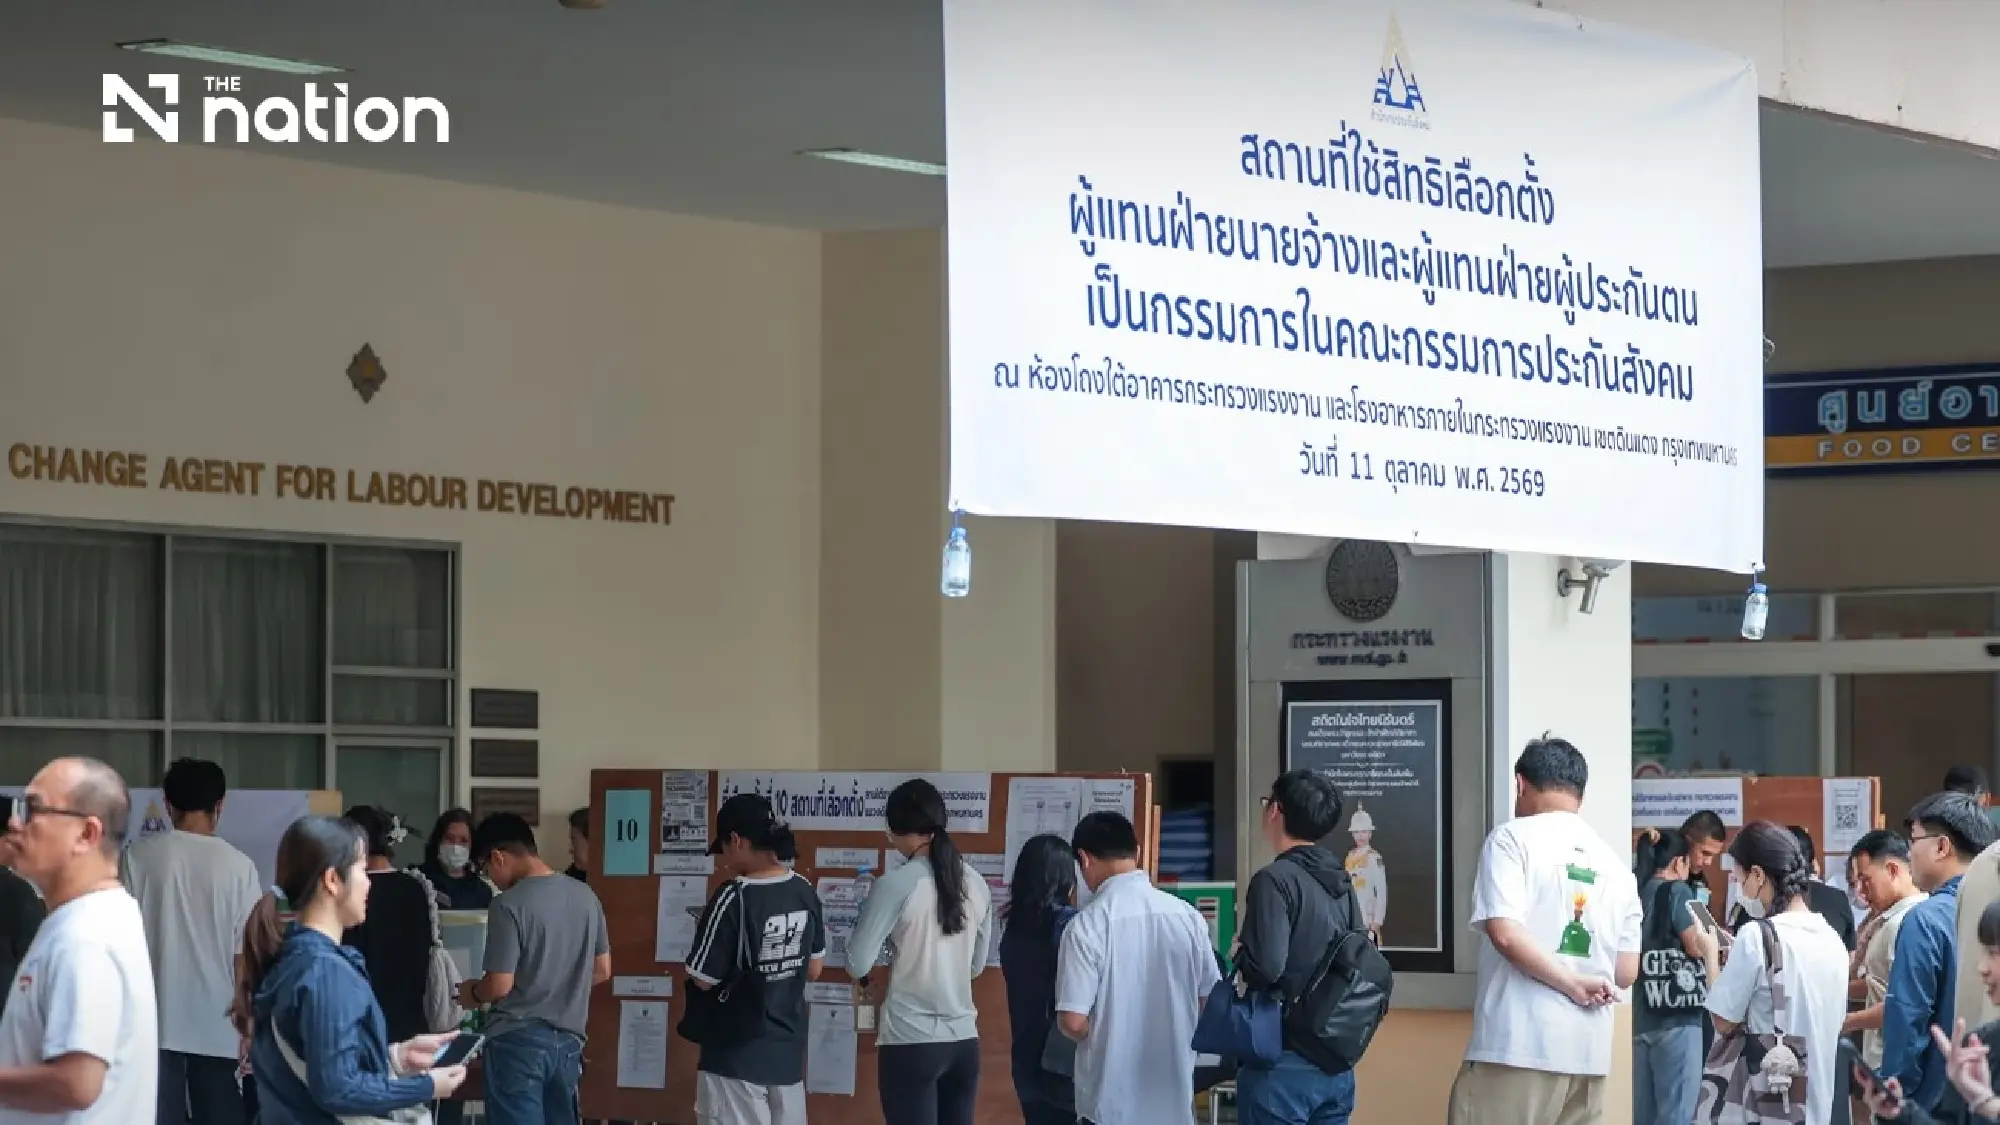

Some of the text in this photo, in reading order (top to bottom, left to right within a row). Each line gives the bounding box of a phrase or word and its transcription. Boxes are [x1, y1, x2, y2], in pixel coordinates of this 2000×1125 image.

[1241, 120, 1555, 226] สถานที่ใช้สิทธิเลือกตั้ง
[1070, 175, 1698, 326] ผู้แทนฝ่ายนายจ้างและผู้แทนฝ่ายผู้ประกันตน
[1087, 262, 1693, 403] เป็นกรรมการในคณะกรรมการประกันสังคม
[994, 362, 1019, 389] ณ
[1028, 354, 1321, 418] ห้องโถงใต้อาคารกระทรวงแรงงาน
[1326, 385, 1592, 448] และโรงอาหารภายในกระทรวงแรงงาน
[1594, 426, 1658, 455] เขตดินแดง
[1818, 433, 2000, 458] FOOD CE
[8, 442, 675, 525] CHANGE AGENT FOR LABOUR DEVELOPMENT
[1299, 434, 1545, 497] วันที่ 11 ตุลาคม พ.ศ. 2569
[616, 818, 638, 842] 10
